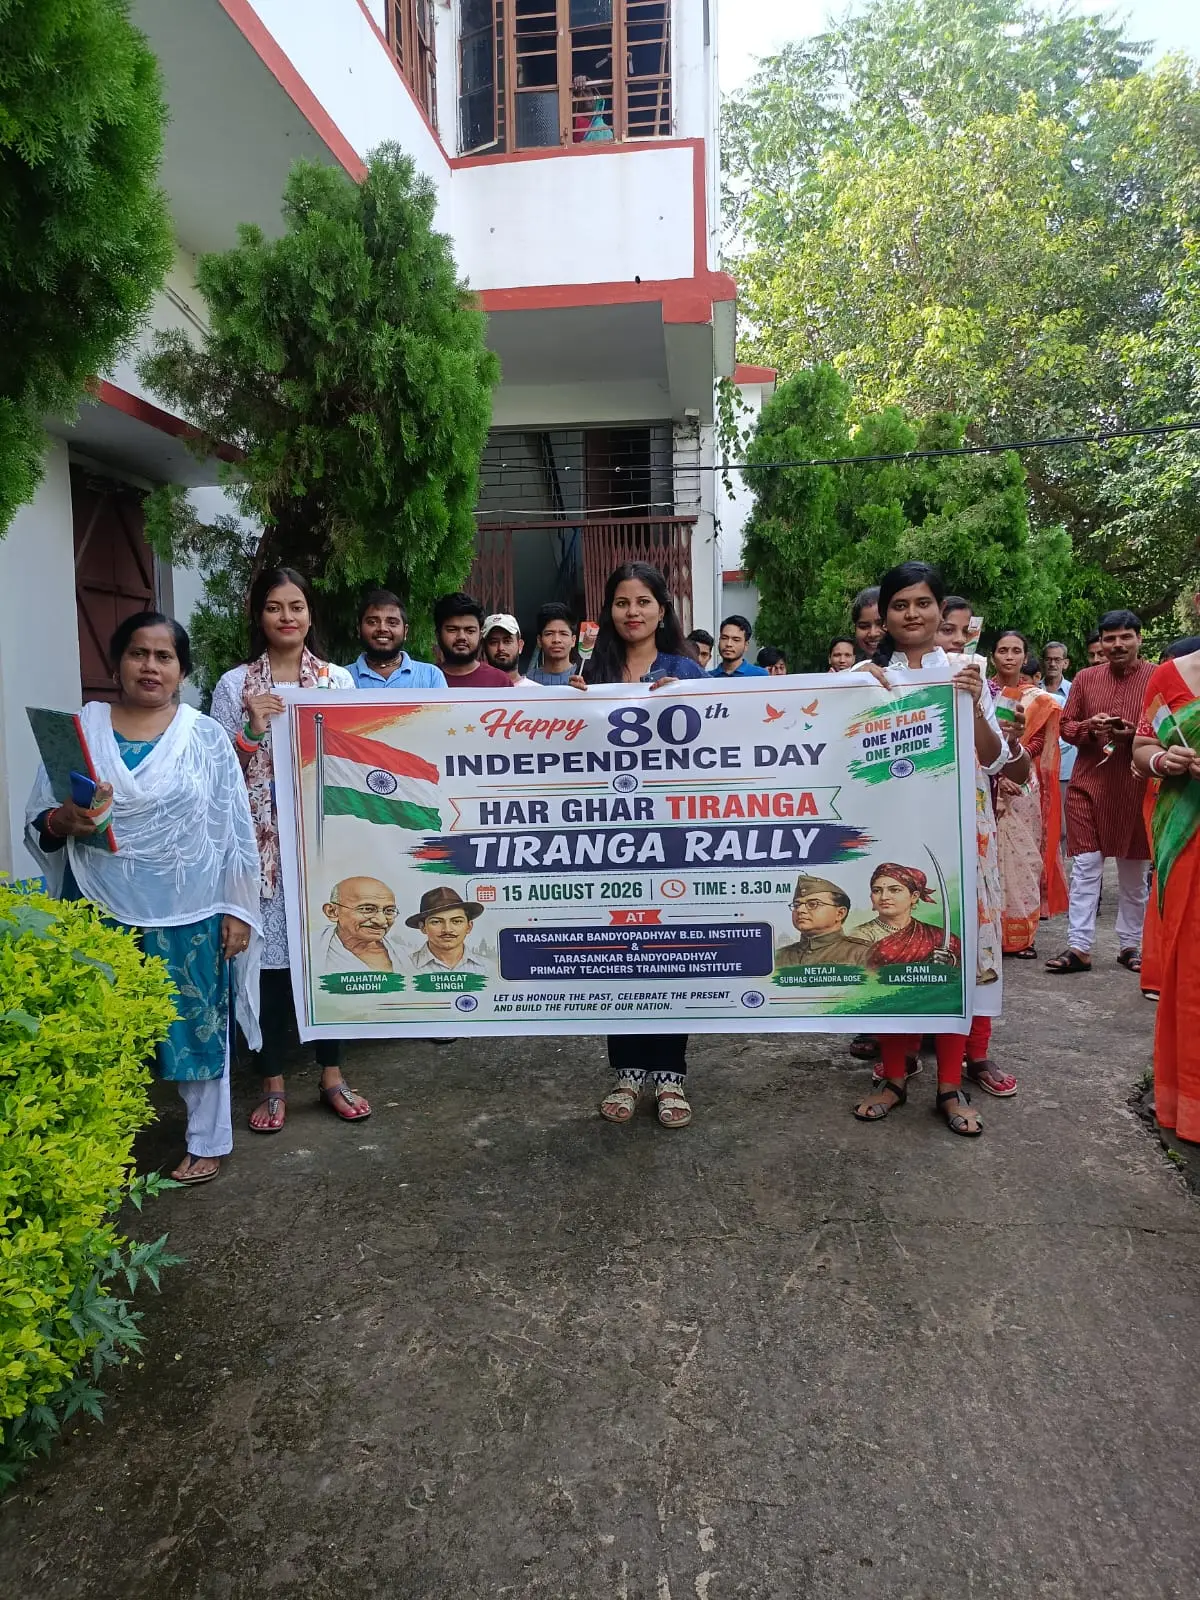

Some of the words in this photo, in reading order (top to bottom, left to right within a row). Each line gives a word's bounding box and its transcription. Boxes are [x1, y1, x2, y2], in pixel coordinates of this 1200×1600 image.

[480, 708, 588, 741] Happy
[865, 718, 891, 733] ONE
[896, 710, 926, 727] FLAG
[862, 734, 887, 748] ONE
[891, 723, 932, 742] NATION
[866, 747, 890, 761] ONE
[894, 738, 930, 755] PRIDE
[445, 745, 741, 776] INDEPENDENCE
[754, 743, 827, 768] DAY
[479, 801, 548, 825] HAR
[561, 797, 654, 822] GHAR
[665, 792, 819, 820] TIRANGA
[469, 831, 666, 868] TIRANGA
[685, 828, 820, 863] RALLY
[502, 885, 522, 901] 15
[528, 883, 595, 900] AUGUST
[601, 882, 643, 899] 2026
[693, 882, 727, 895] TIME
[740, 881, 772, 894] 8.30
[775, 883, 791, 893] AM
[626, 912, 646, 922] AT
[514, 933, 584, 943] TARASANKAR
[587, 931, 677, 941] BANDYOPADHYAY
[680, 930, 706, 939] B.ED.
[709, 929, 761, 939] INSTITUTE
[631, 942, 639, 951] &
[553, 954, 623, 963] TARASANKAR
[626, 952, 718, 962] BANDYOPADHYAY
[530, 966, 577, 975] PRIMARY
[580, 965, 634, 974] TEACHERS
[636, 964, 686, 973] TRAINING
[689, 963, 742, 972] INSTITUTE
[804, 967, 836, 975] NETAJI
[906, 966, 930, 974] RANI
[340, 975, 388, 983] MAHATMA
[430, 974, 467, 982] BHAGAT
[779, 975, 807, 984] SUBHAS
[808, 975, 842, 983] CHANDRA
[843, 974, 861, 982] BOSE
[888, 975, 947, 983] LAKSHMIBAI
[345, 983, 381, 991] GANDHI
[435, 982, 464, 990] SINGH
[493, 994, 509, 1002] LET
[527, 993, 566, 1001] HONOUR
[568, 993, 585, 1001] THE
[588, 993, 613, 1001] PAST,
[618, 992, 668, 1000] CELEBRATE
[670, 992, 687, 1000] THE
[494, 1004, 513, 1012] AND
[545, 1003, 561, 1011] THE
[564, 1003, 598, 1011] FUTURE
[636, 1002, 673, 1010] NATION.
